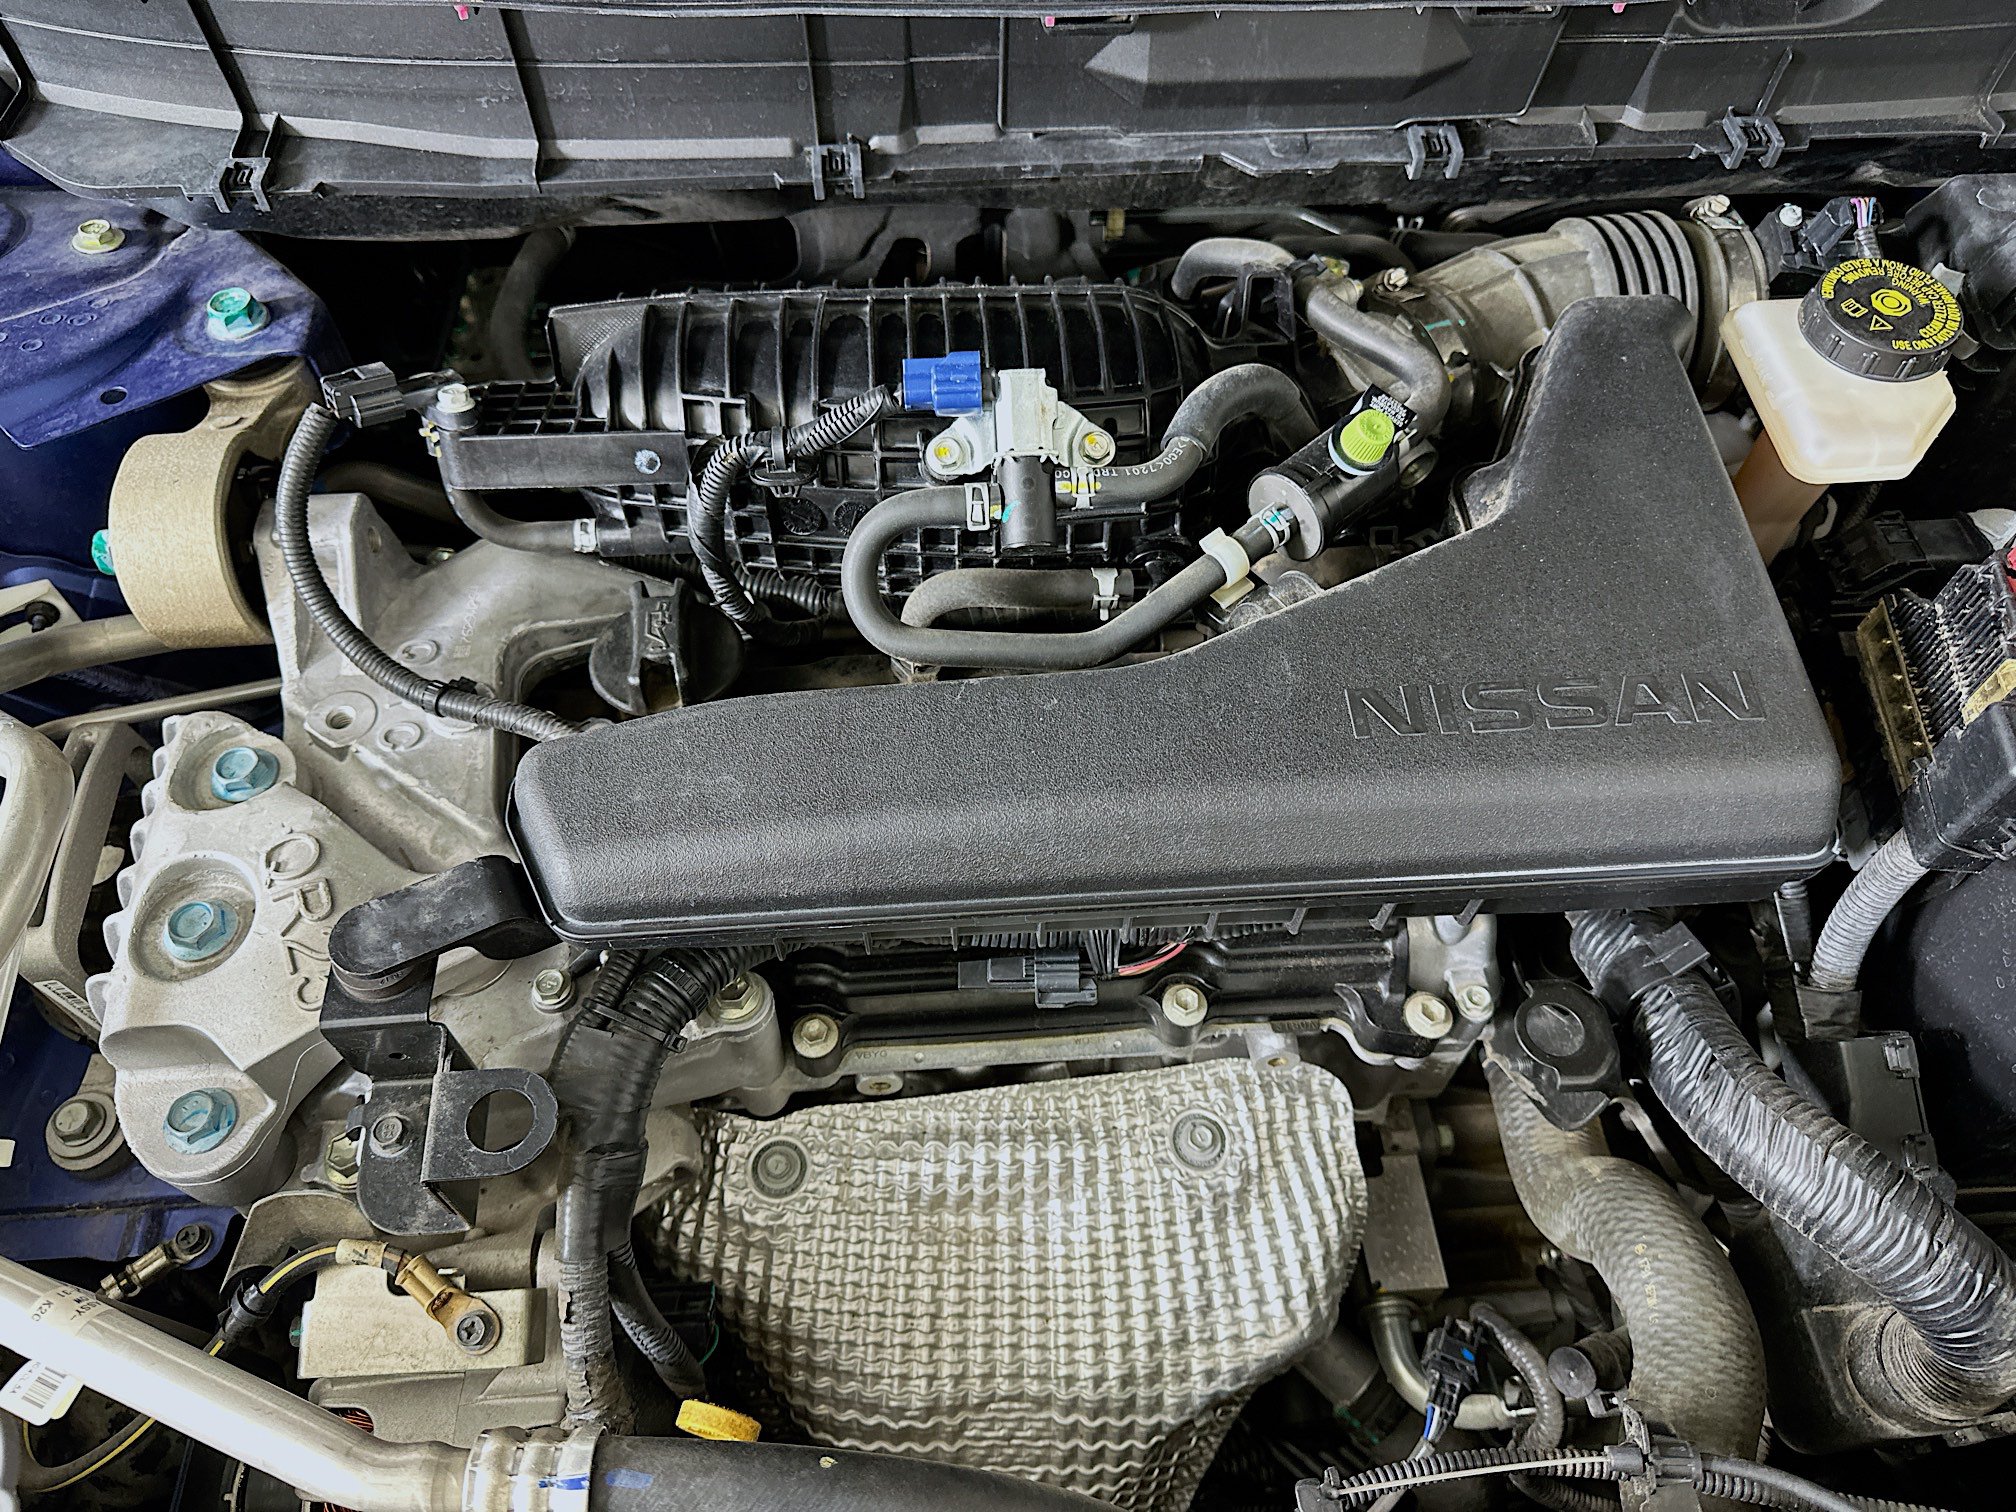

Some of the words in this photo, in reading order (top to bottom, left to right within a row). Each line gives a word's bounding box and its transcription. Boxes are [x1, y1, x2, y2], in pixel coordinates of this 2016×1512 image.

[1840, 258, 1872, 272] SEALED
[1872, 258, 1879, 266] A
[1881, 259, 1908, 274] FROM
[1841, 267, 1885, 284] REMOVING
[1887, 267, 1923, 288] BEFORE
[1909, 267, 1935, 284] FLUID
[1891, 278, 1930, 305] WARNING
[1921, 284, 1938, 300] CAP
[1932, 283, 1957, 305] BRAKE
[1892, 339, 1912, 350] USE
[1913, 338, 1937, 350] ONLY
[1343, 669, 1766, 739] NISSAN
